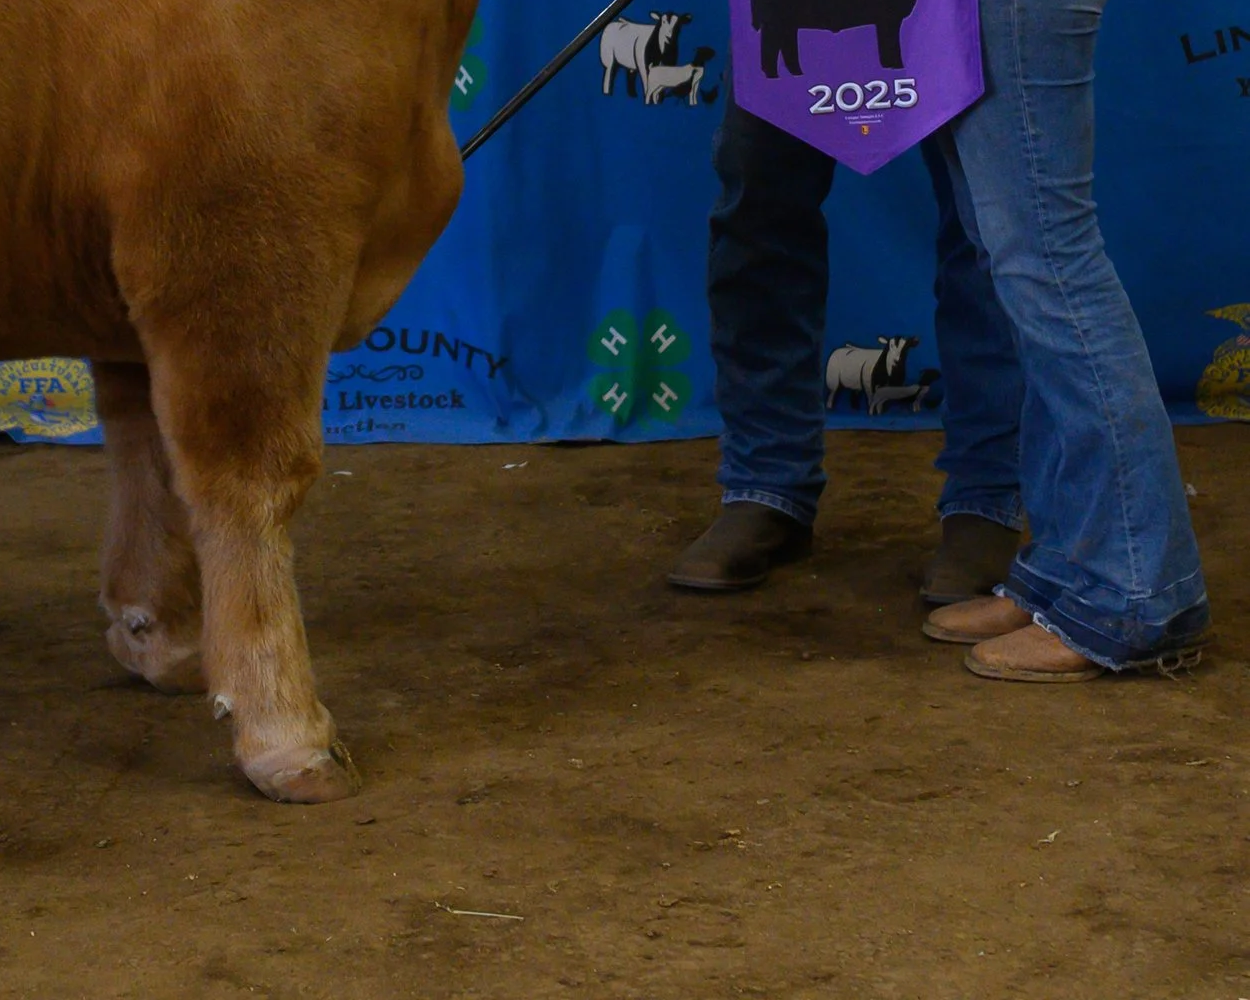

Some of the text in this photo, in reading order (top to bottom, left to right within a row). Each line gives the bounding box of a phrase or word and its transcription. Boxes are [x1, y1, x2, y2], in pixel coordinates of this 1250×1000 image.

[808, 78, 918, 114] 2025
[18, 377, 66, 394] FFA
[338, 388, 466, 411] Livestock
